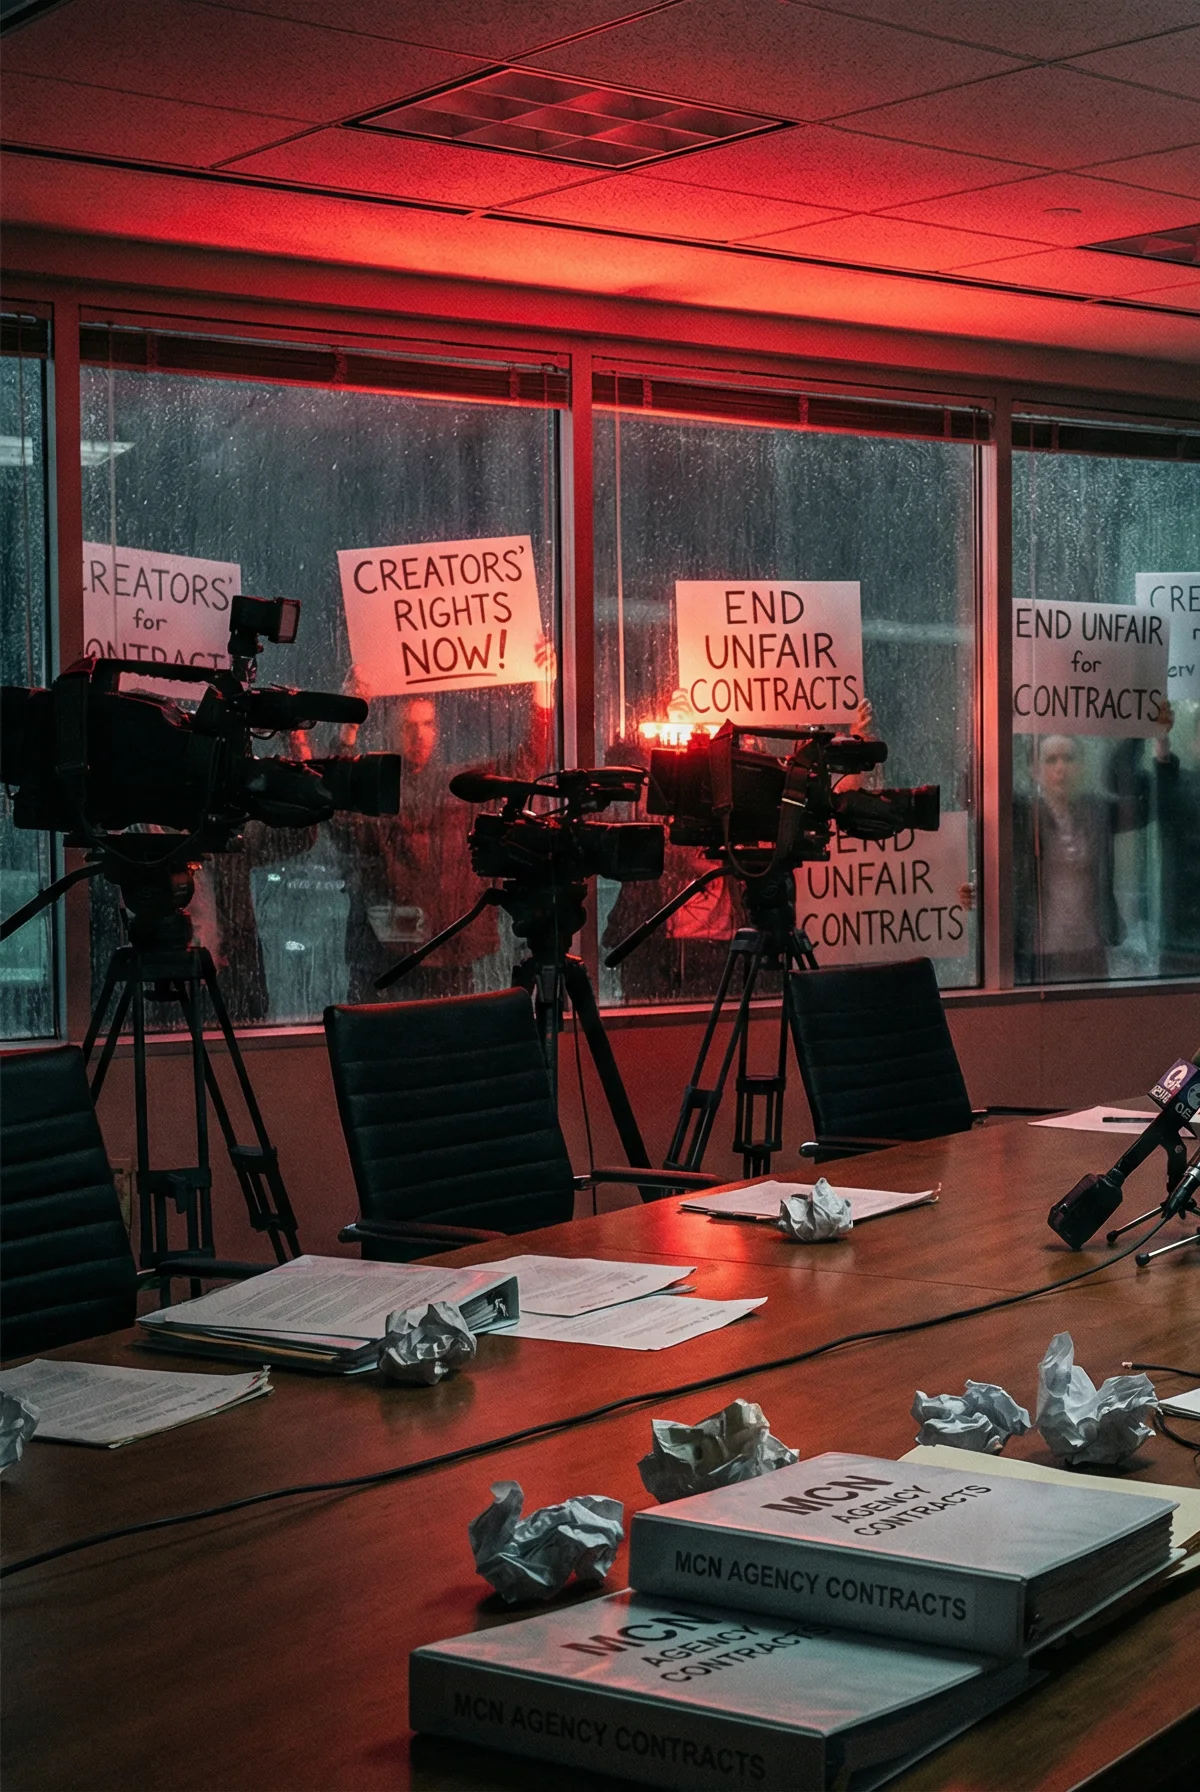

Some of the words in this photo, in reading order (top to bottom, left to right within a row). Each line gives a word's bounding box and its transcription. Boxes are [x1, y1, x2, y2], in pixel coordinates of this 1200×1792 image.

[83, 560, 233, 611] REATORS'
[353, 545, 525, 594] CREATORS'
[133, 608, 168, 631] for
[394, 591, 512, 632] RIGHTS
[725, 590, 804, 624] END
[1016, 608, 1072, 639] END
[1082, 612, 1163, 646] UNFAIR
[402, 629, 508, 677] NOW!
[705, 632, 837, 669] UNFAIR
[1071, 650, 1102, 673] for
[690, 675, 859, 713] CONTRACTS
[1014, 684, 1162, 722] CONTRACTS
[807, 860, 933, 899] UNFAIR
[802, 905, 963, 948] CONTRACTS
[761, 1475, 895, 1516] MCN
[832, 1484, 931, 1524] AGENCY
[853, 1485, 992, 1536] CONTRACTS
[675, 1551, 722, 1580] MCN
[728, 1561, 820, 1595] AGENCY
[825, 1577, 967, 1620] CONTRACTS
[561, 1611, 722, 1658] MCN
[641, 1624, 761, 1668] AGENCY
[660, 1622, 833, 1683] CONTRACTS
[453, 1692, 501, 1725] MCN
[510, 1707, 608, 1745] AGENCY
[615, 1726, 767, 1780] CONTRACTS
